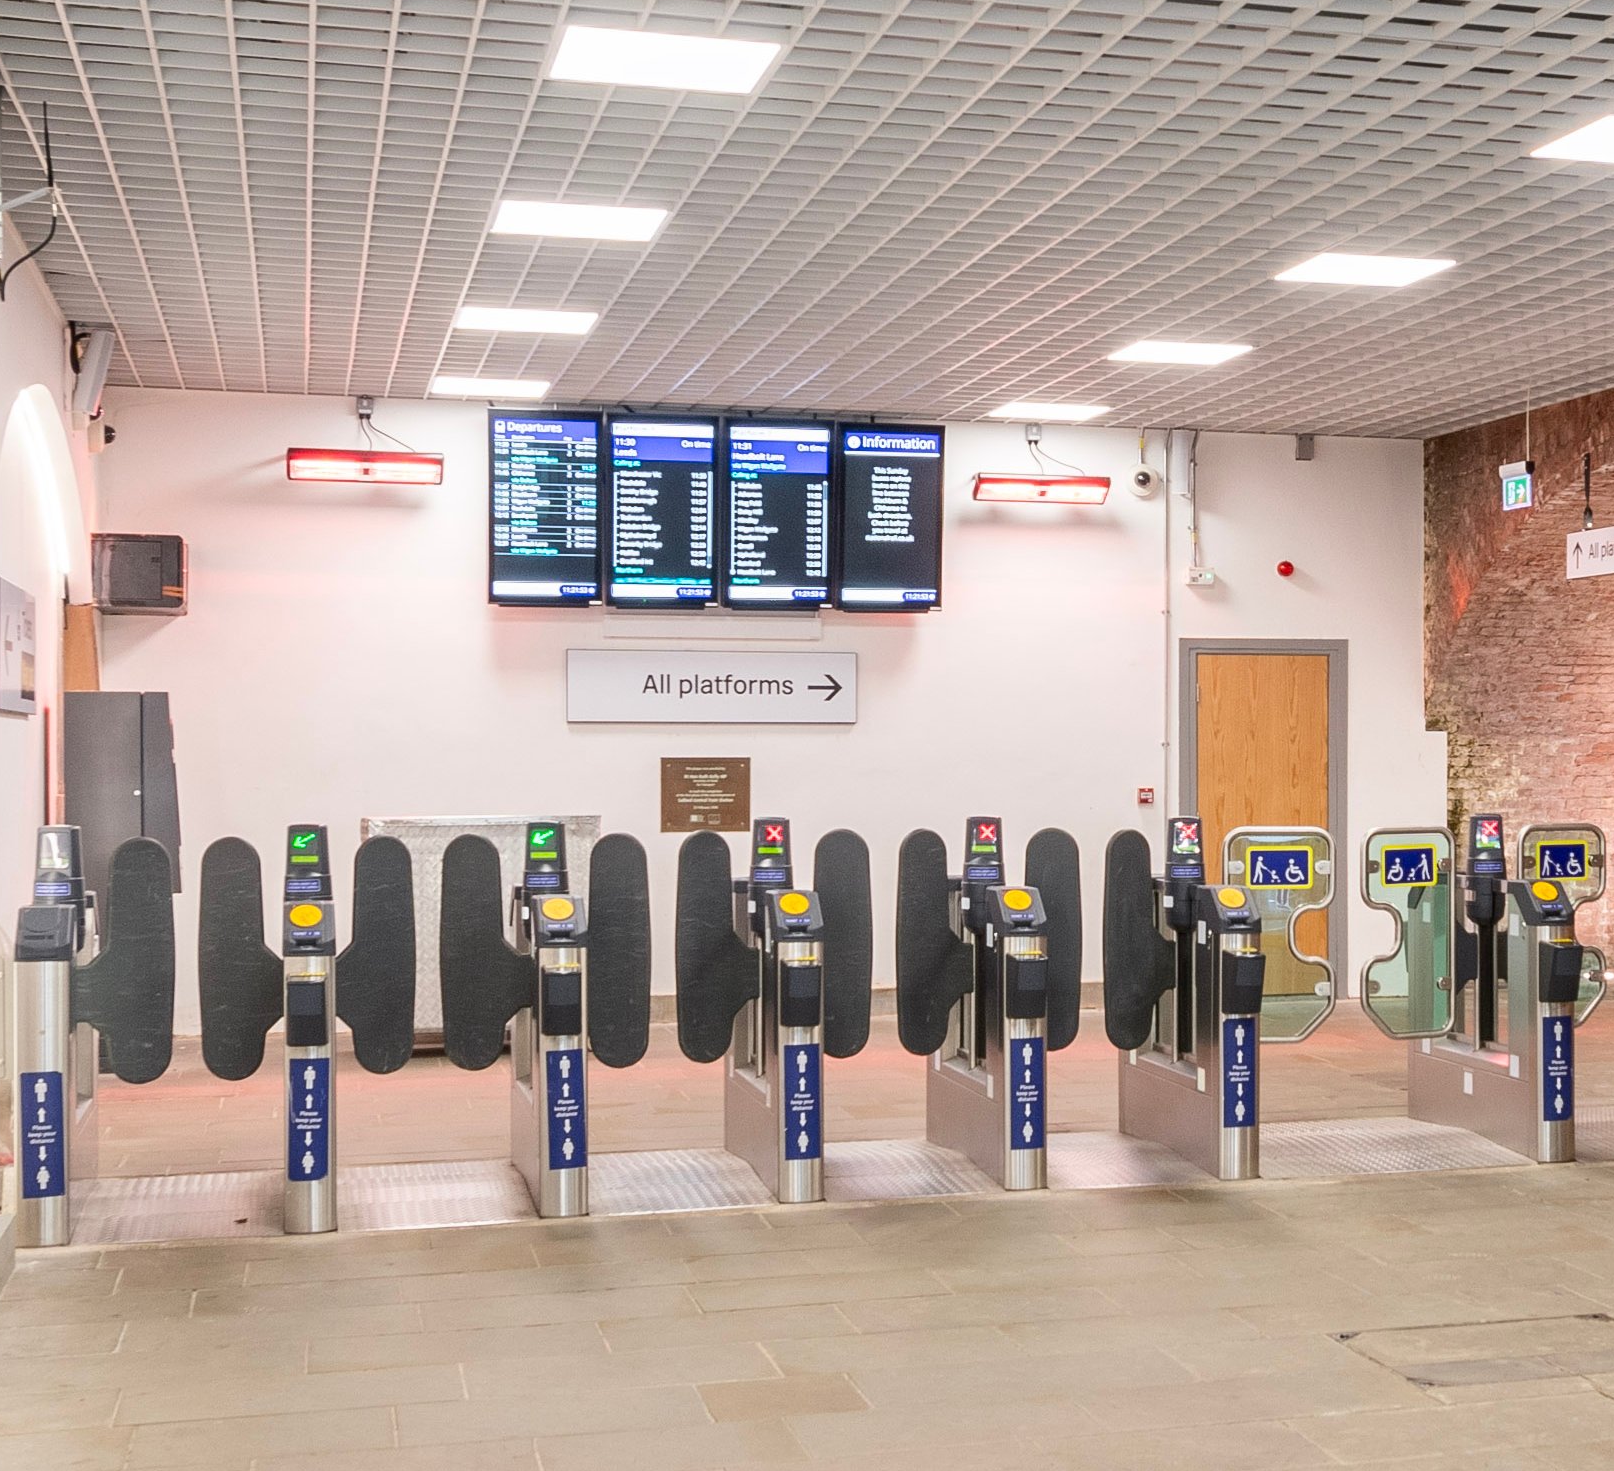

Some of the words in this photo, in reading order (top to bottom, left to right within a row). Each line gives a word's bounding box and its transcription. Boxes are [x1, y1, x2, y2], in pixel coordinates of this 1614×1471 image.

[506, 421, 563, 434] Departures
[862, 435, 937, 450] Information
[1588, 542, 1598, 559] All
[642, 674, 671, 694] All
[679, 674, 794, 698] platforms
